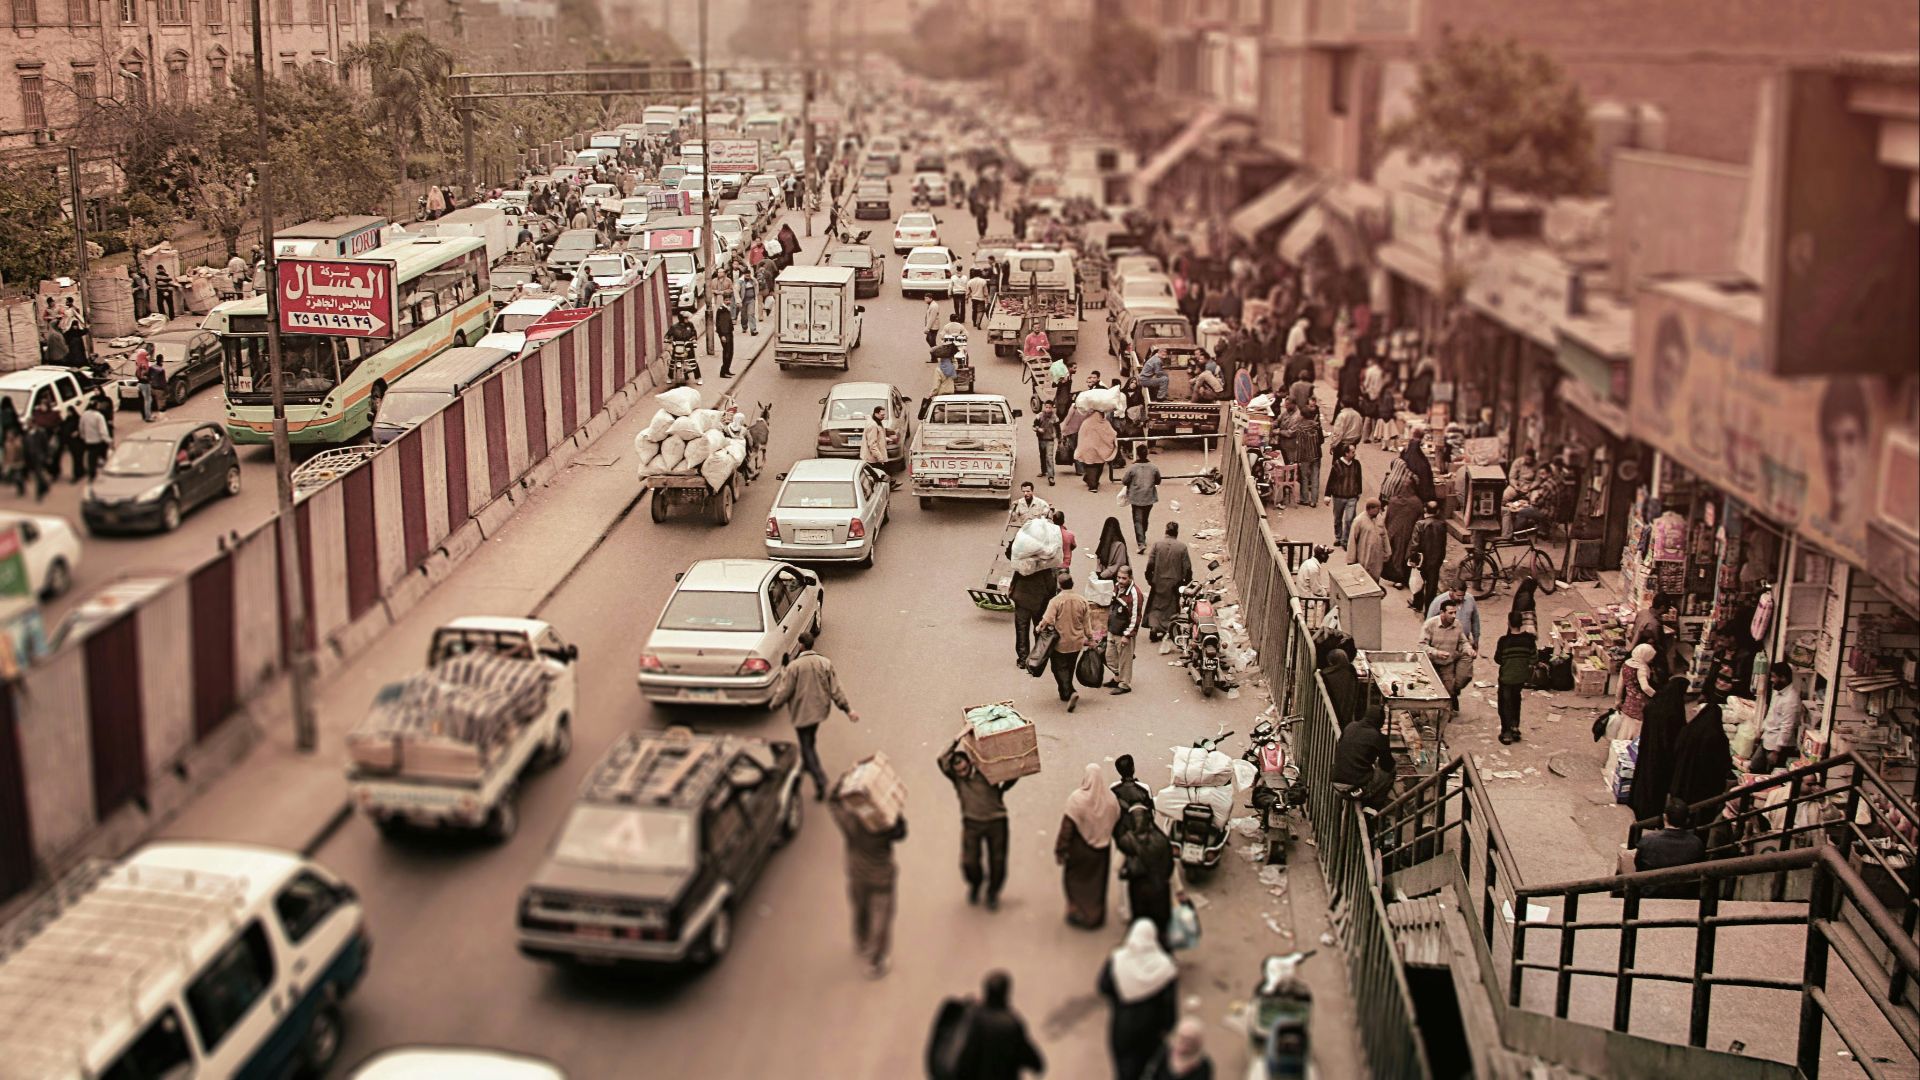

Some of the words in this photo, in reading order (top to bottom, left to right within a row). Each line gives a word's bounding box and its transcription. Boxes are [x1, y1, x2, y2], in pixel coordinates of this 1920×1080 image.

[351, 229, 378, 255] LORD
[319, 265, 350, 277] شركة
[286, 264, 384, 299] العسال
[930, 460, 993, 470] NISSAN
